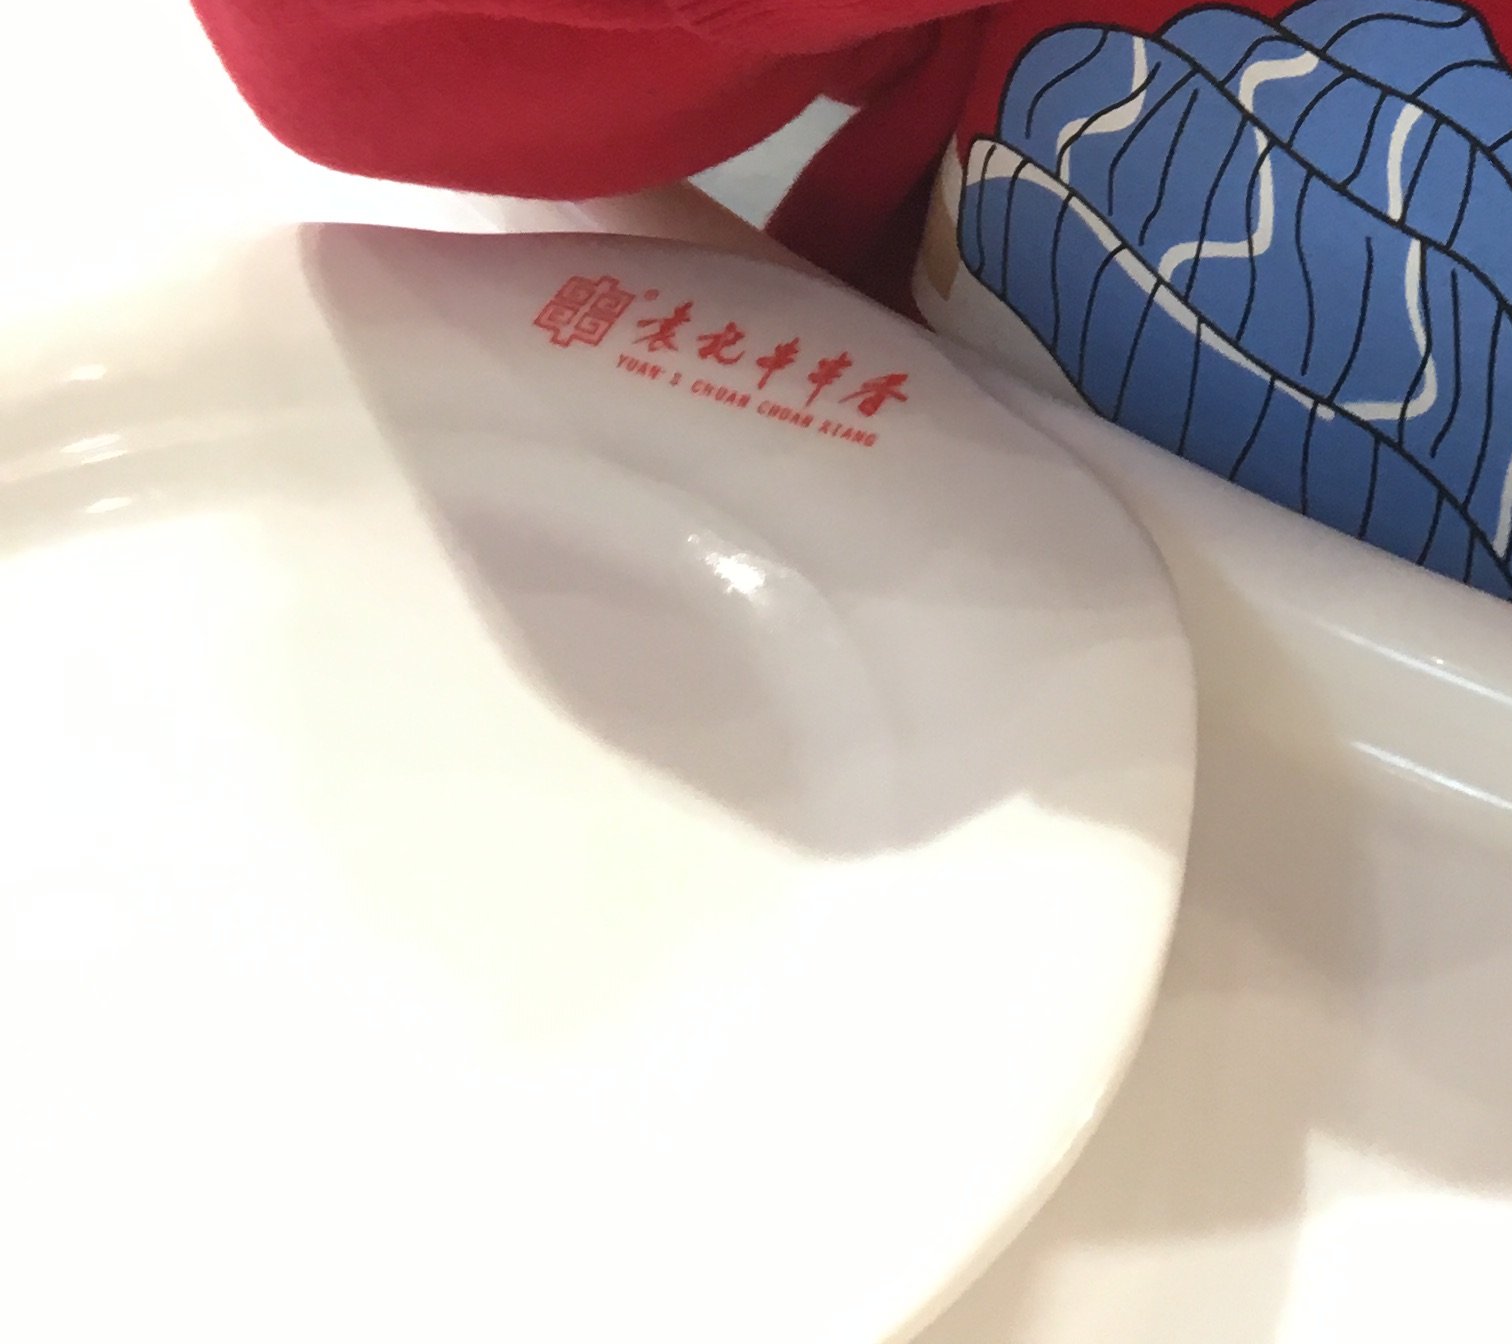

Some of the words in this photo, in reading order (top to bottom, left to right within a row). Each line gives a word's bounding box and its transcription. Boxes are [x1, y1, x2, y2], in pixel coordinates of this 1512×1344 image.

[690, 378, 752, 408] CHUAN
[756, 399, 815, 429] CHUAN
[818, 418, 879, 448] XIANG
